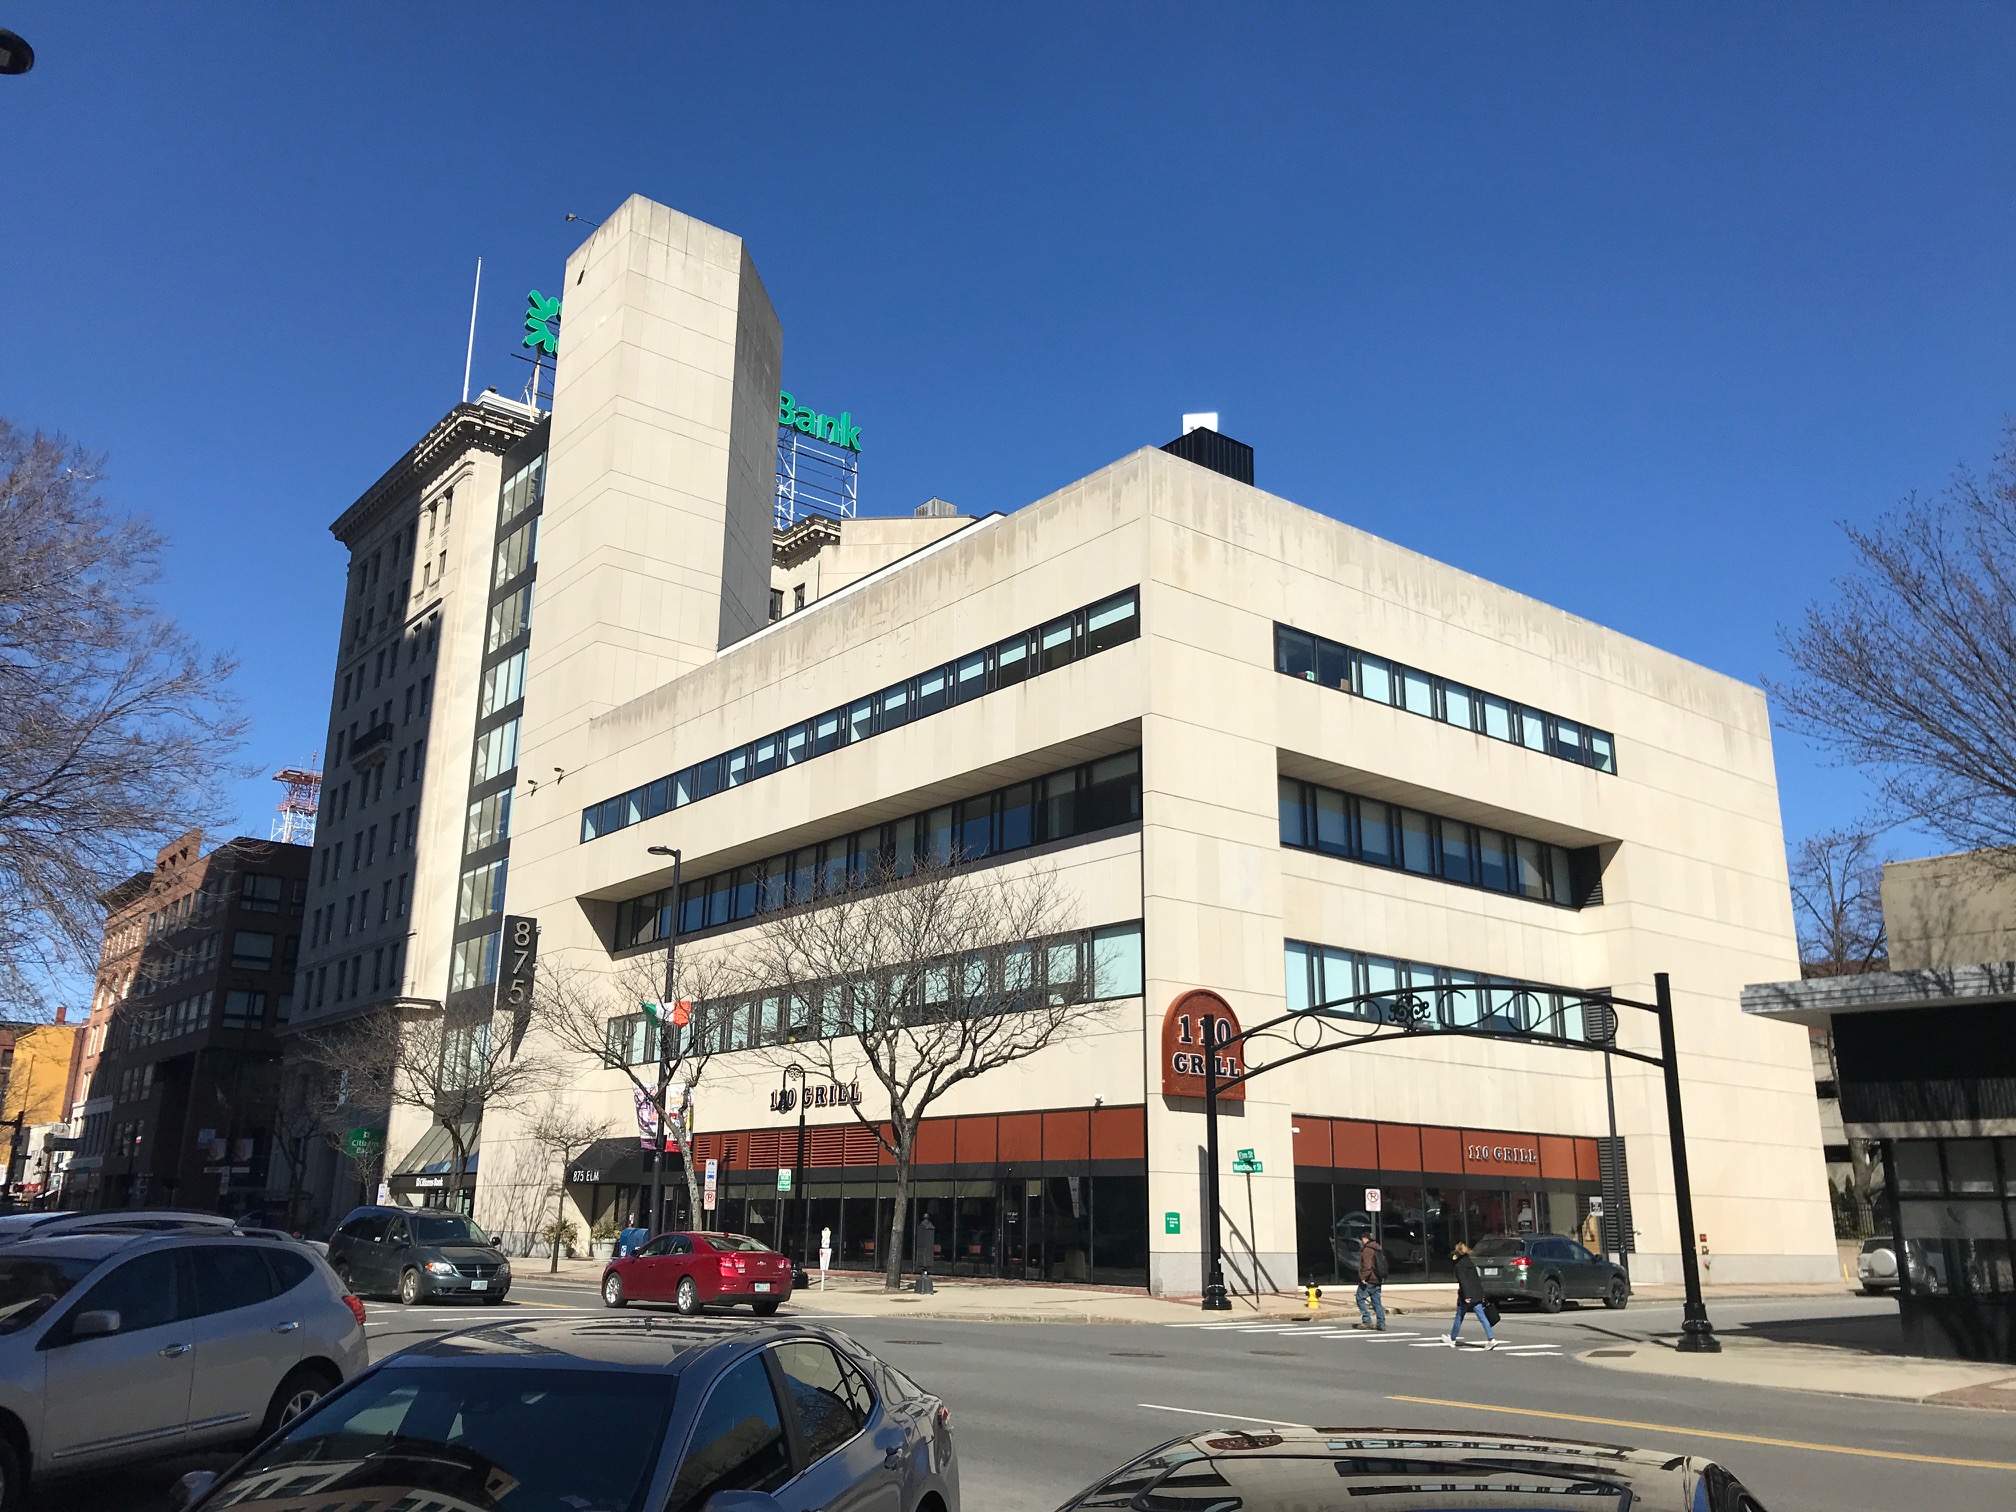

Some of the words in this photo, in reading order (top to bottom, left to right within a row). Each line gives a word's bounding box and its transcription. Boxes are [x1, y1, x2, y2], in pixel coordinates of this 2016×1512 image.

[779, 390, 862, 452] Bank
[508, 921, 530, 1004] 875
[1172, 1052, 1241, 1079] GRLL
[770, 1088, 797, 1111] 10
[803, 1082, 862, 1109] GRILL
[1233, 1163, 1256, 1171] Manchesr
[1468, 1144, 1490, 1161] 110
[1494, 1146, 1537, 1163] GRILL
[573, 1170, 585, 1182] 875
[586, 1169, 599, 1181] ELM
